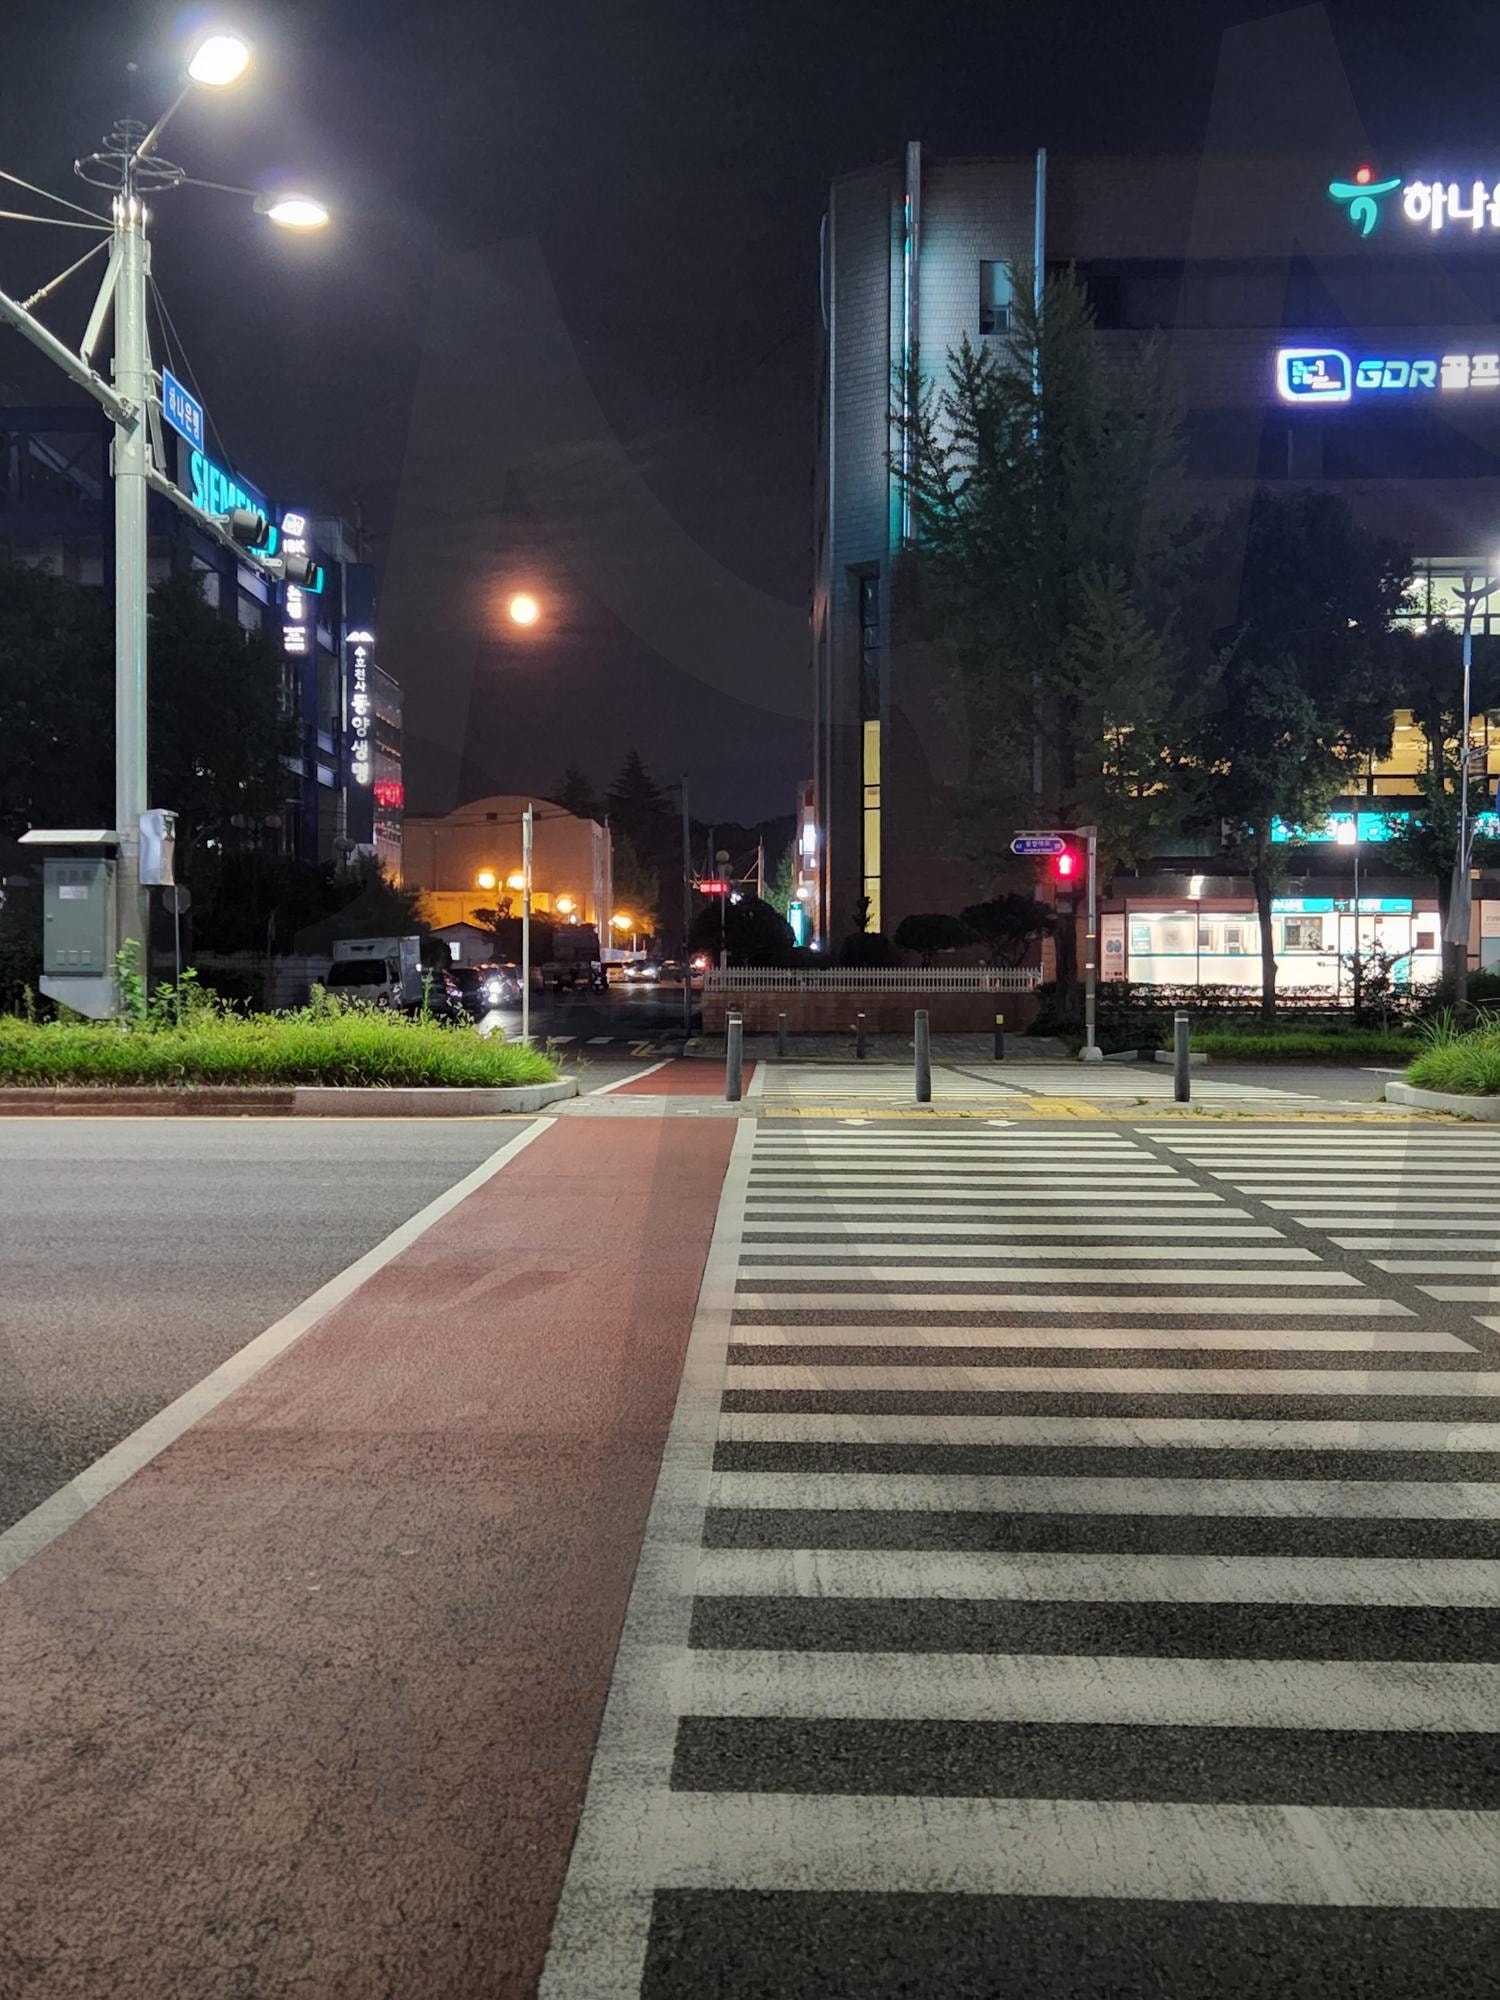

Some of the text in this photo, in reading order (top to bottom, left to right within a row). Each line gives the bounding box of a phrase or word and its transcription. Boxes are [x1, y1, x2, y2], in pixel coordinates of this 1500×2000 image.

[169, 386, 199, 441] 하나은행
[351, 645, 370, 784] 수호천사 동양생명
